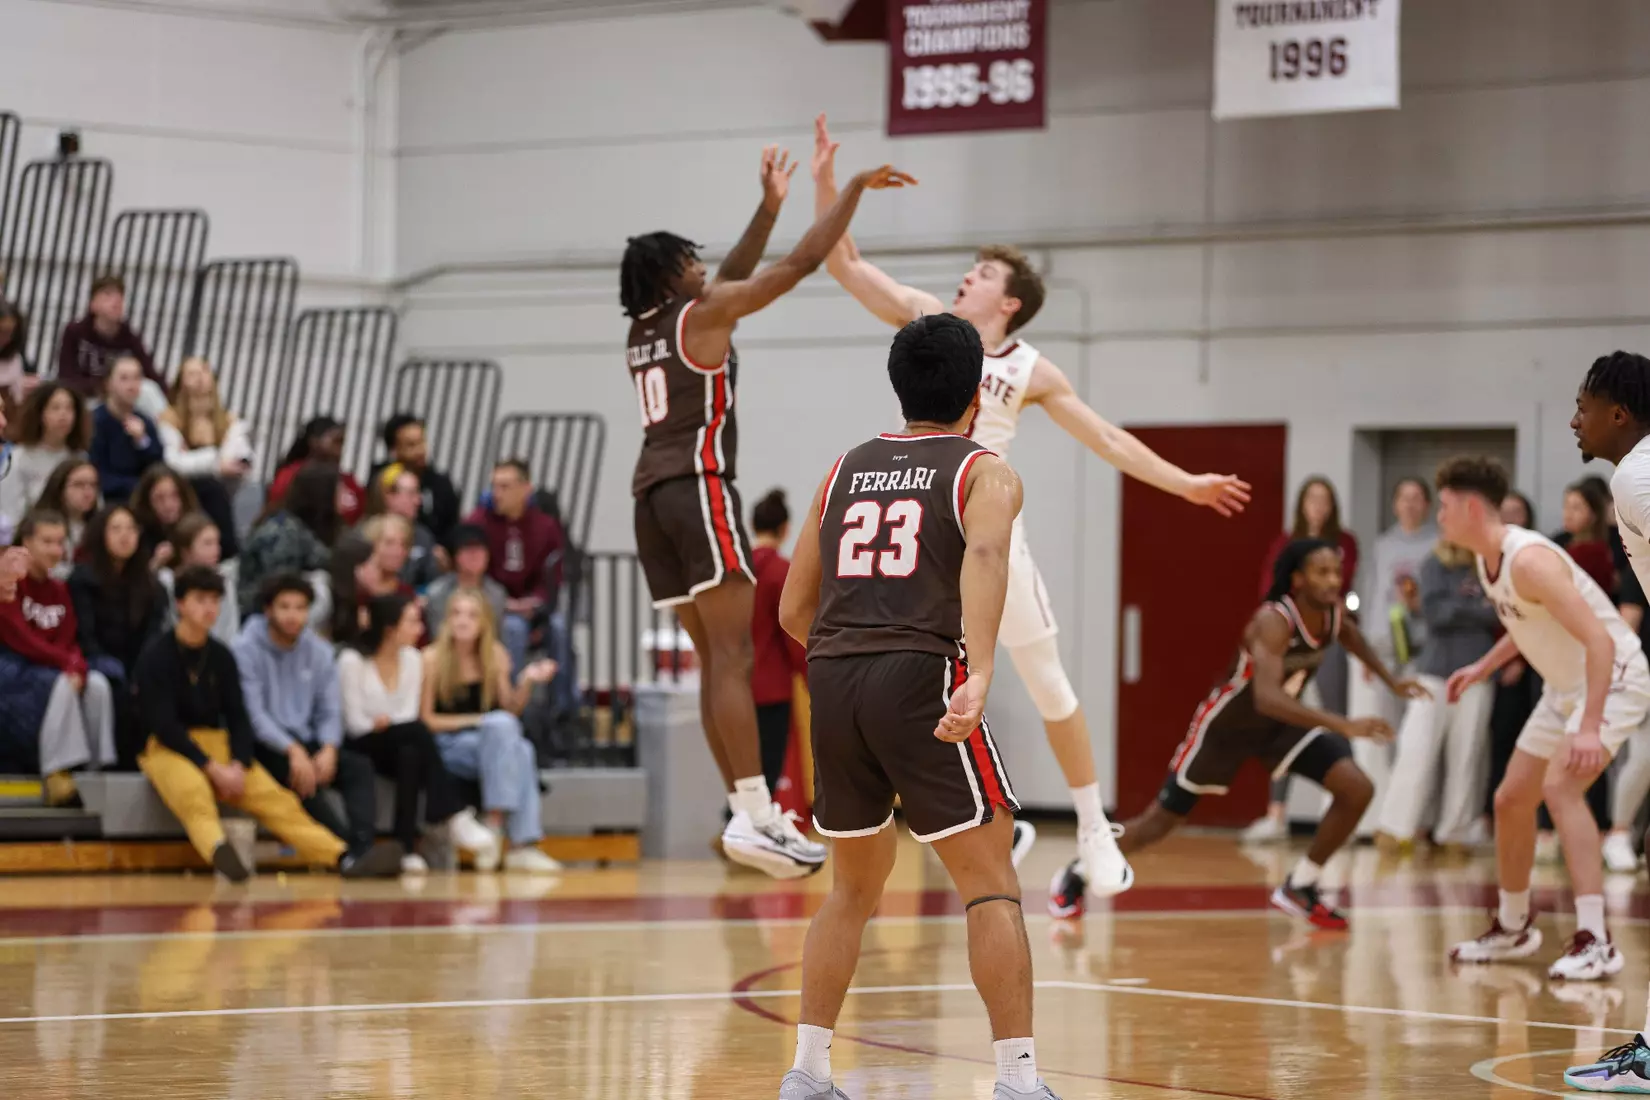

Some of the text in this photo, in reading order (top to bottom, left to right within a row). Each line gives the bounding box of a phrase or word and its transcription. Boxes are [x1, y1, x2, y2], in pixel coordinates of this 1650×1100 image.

[1233, 0, 1380, 28] TOURNAMENT
[903, 22, 1030, 57] CHAMPIONS
[1269, 35, 1348, 82] 1996
[902, 58, 1035, 110] 1995-96
[634, 365, 669, 428] 10
[849, 467, 936, 494] FERRARI
[836, 498, 924, 578] 23
